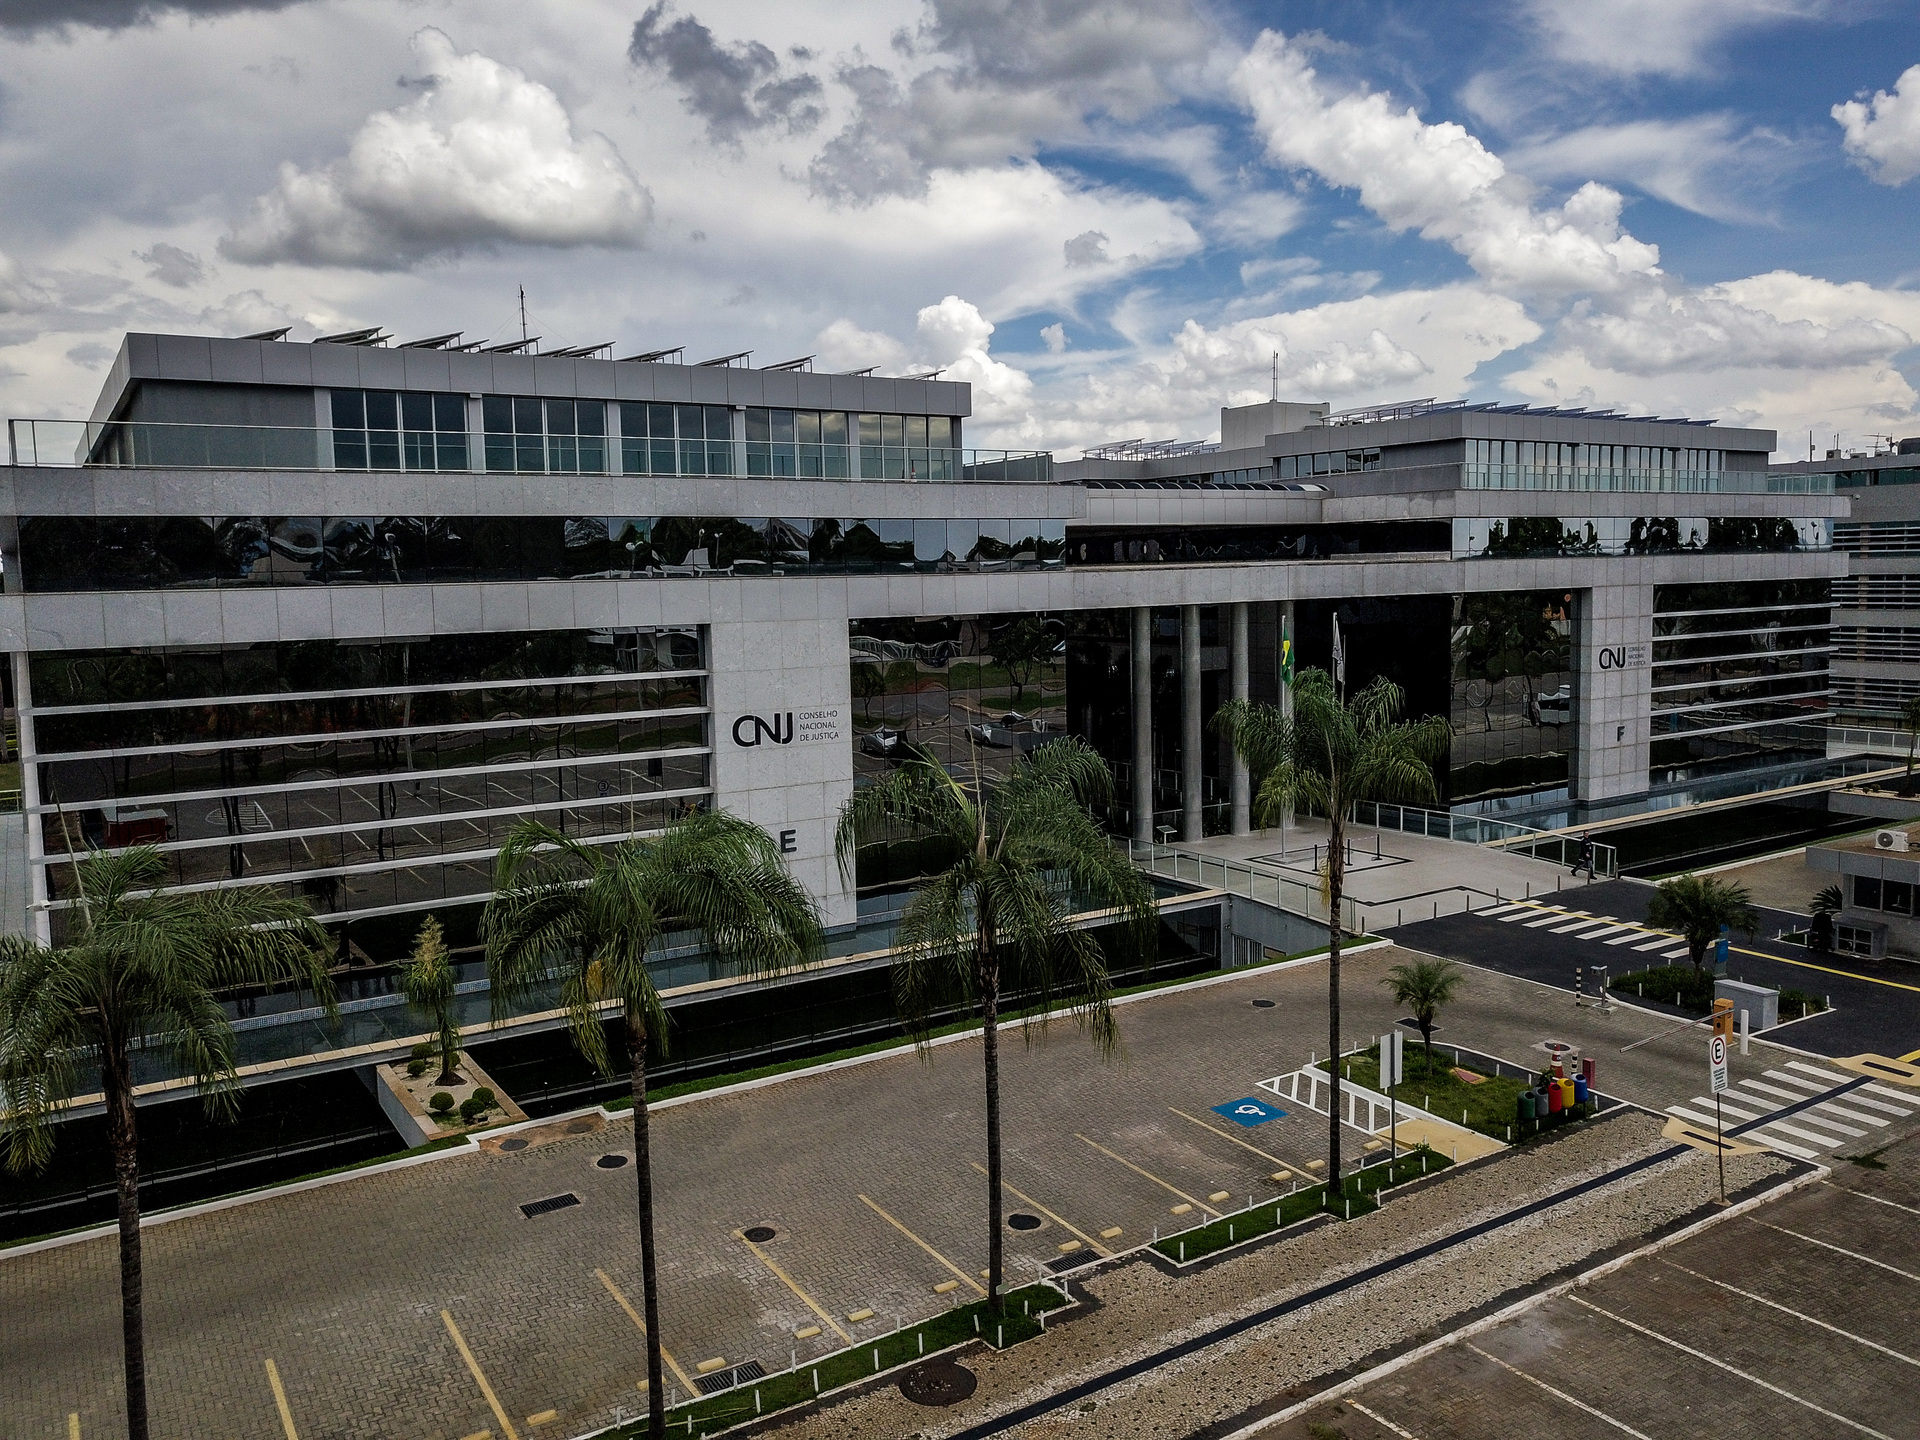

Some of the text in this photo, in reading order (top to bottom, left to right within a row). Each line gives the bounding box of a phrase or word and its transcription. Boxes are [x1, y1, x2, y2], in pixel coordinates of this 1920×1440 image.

[1599, 647, 1626, 669] CNJ
[799, 709, 838, 720] CONSELHO
[732, 712, 794, 747] CNJ
[799, 721, 836, 730] NACIONAL
[811, 731, 839, 740] JUSTIÇA
[1616, 726, 1625, 742] F
[780, 829, 797, 854] E
[1715, 1043, 1721, 1059] E
